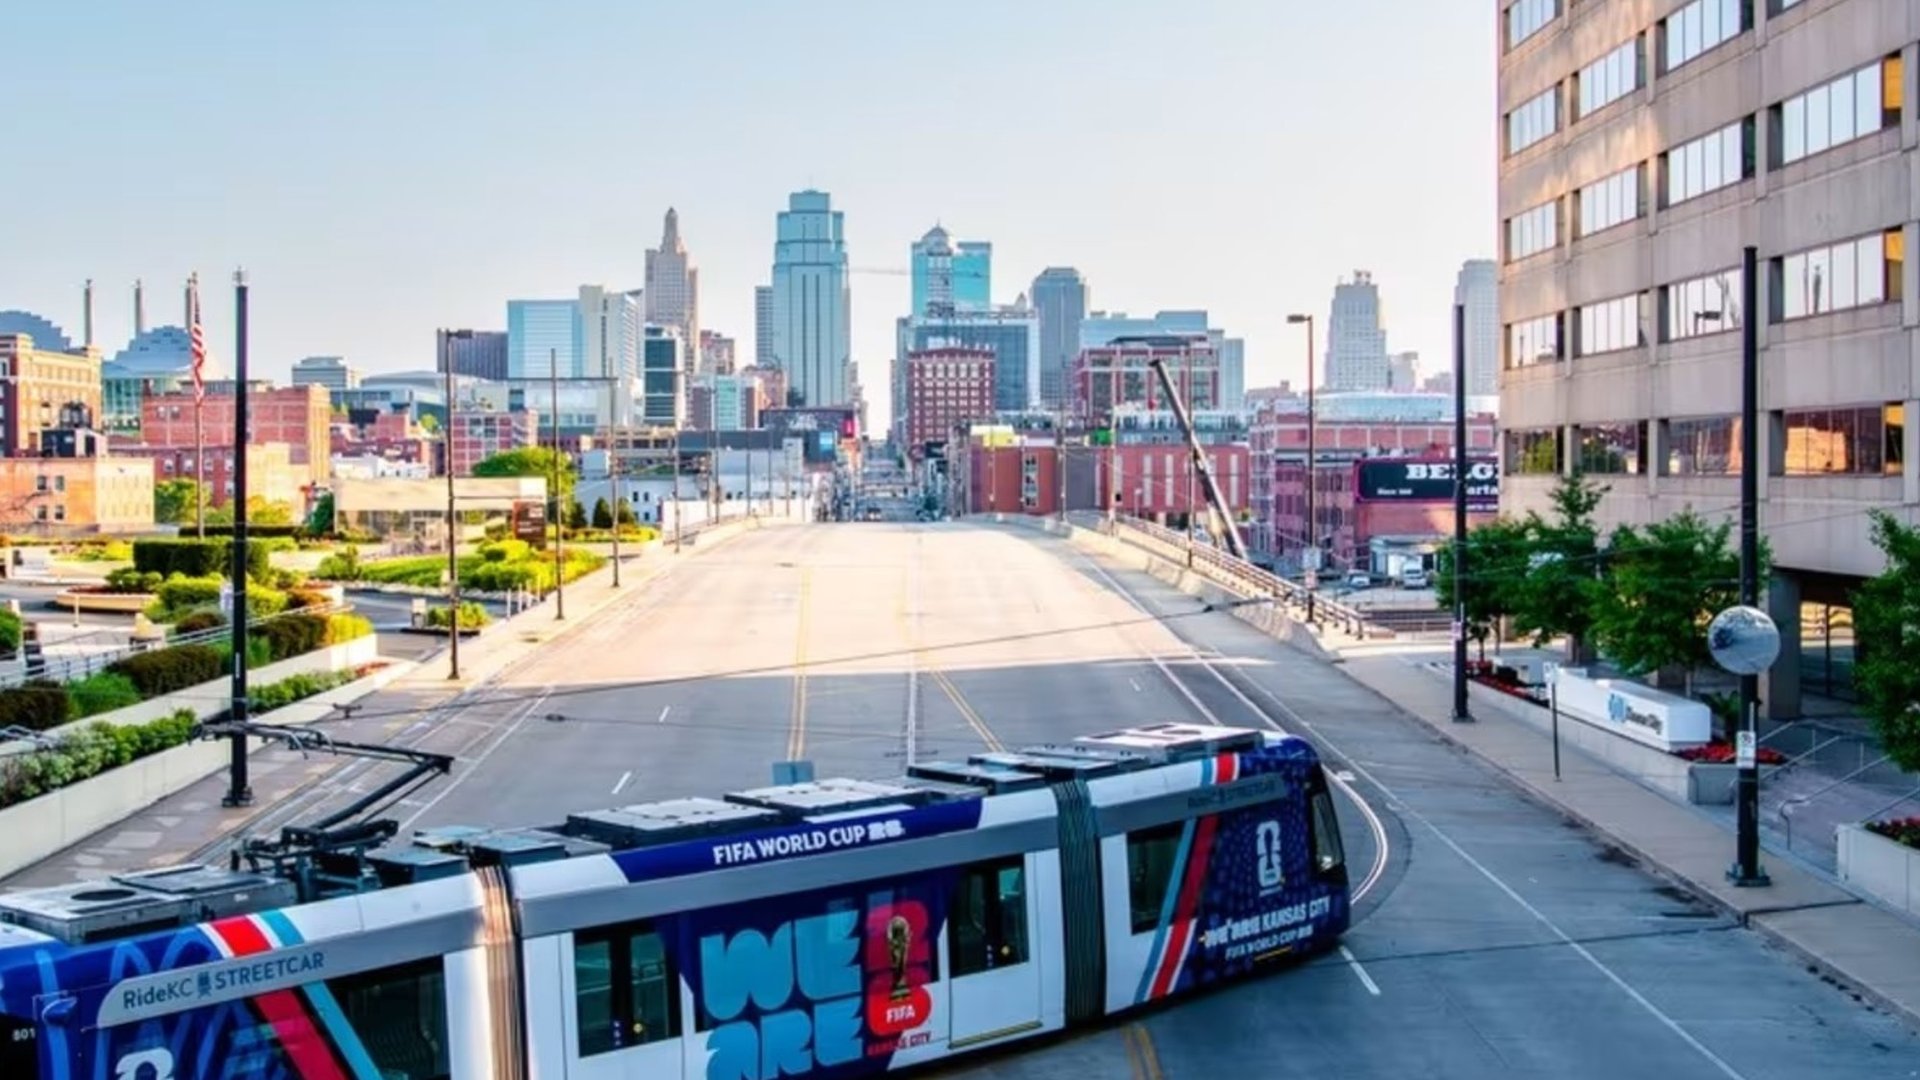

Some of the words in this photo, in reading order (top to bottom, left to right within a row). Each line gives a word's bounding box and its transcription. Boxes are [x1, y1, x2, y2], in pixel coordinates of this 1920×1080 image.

[1405, 463, 1498, 479] BEG
[712, 841, 757, 865] FIFA
[757, 831, 826, 858] WORLD
[829, 824, 866, 846] CUP
[122, 978, 194, 1009] RideKC
[215, 951, 325, 990] STREETCAR
[701, 909, 862, 1020] WE
[706, 996, 864, 1080] ARE
[886, 1004, 916, 1024] FIFA
